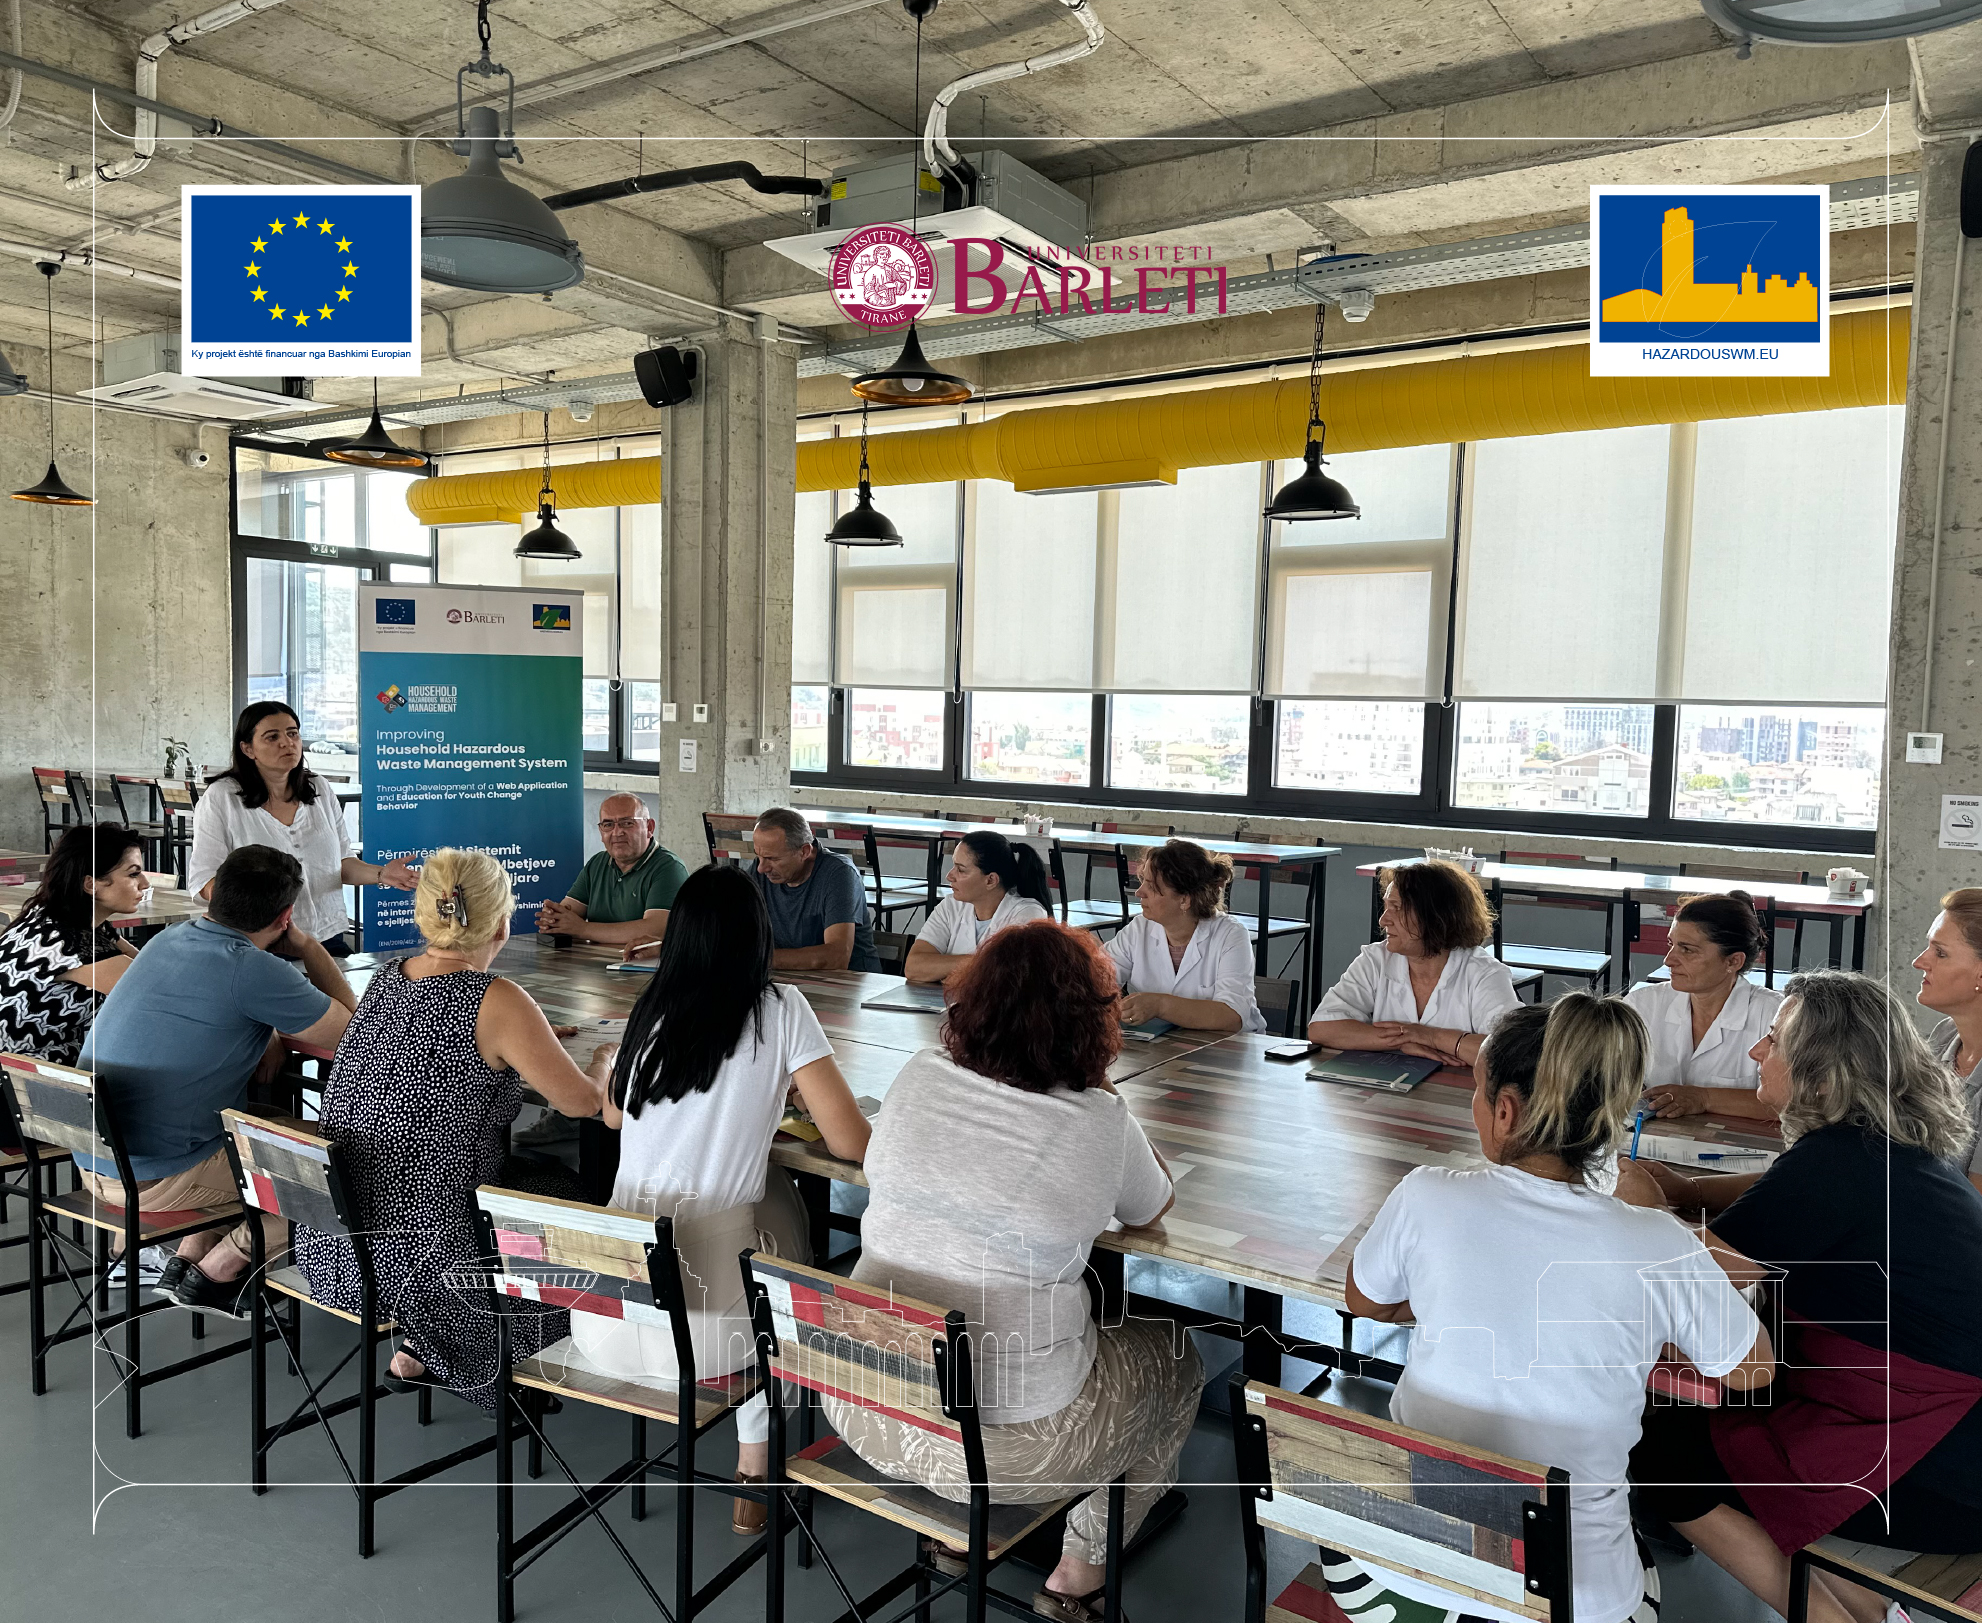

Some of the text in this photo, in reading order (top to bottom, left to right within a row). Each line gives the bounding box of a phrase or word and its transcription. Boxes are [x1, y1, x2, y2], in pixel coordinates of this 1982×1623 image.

[464, 610, 505, 624] BARLETI
[408, 685, 457, 697] HOUSEHOLD
[408, 703, 457, 713] MANAGEMENT
[376, 728, 445, 743] Improving
[376, 743, 526, 755] Household Hazardous
[376, 758, 568, 772] Waste Management System
[376, 783, 414, 794] Through
[416, 783, 475, 794] Development
[477, 782, 486, 790] of
[496, 782, 517, 790] Web
[518, 781, 568, 792] Application
[376, 791, 523, 802] and Education for Youth Change
[376, 801, 418, 811] Behavior
[466, 843, 522, 856] Sistemit
[377, 899, 409, 908] Përmes
[377, 908, 415, 917] në intern
[384, 917, 415, 928] sjelljes
